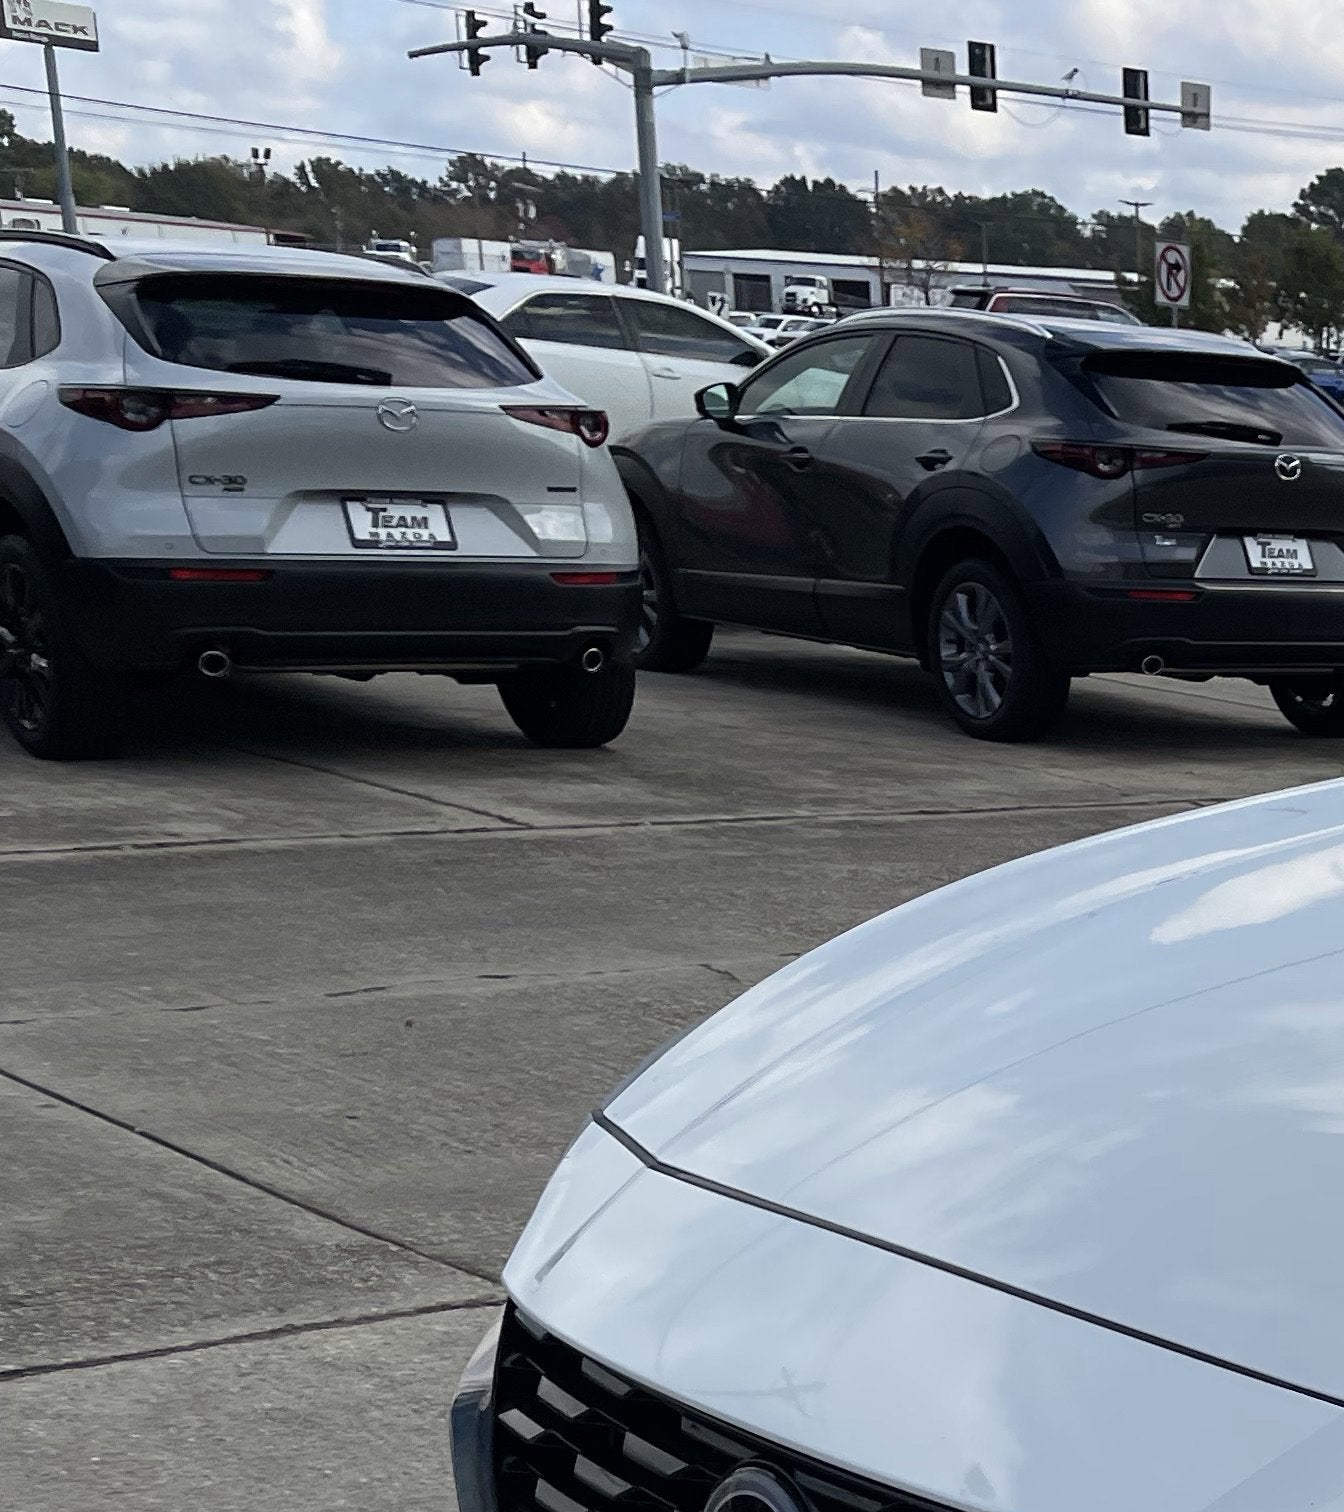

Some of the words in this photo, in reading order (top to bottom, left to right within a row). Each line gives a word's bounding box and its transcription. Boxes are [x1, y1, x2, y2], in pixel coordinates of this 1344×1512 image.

[12, 15, 89, 36] MACK
[365, 507, 429, 529] TEAM
[1257, 541, 1298, 560] TEAM
